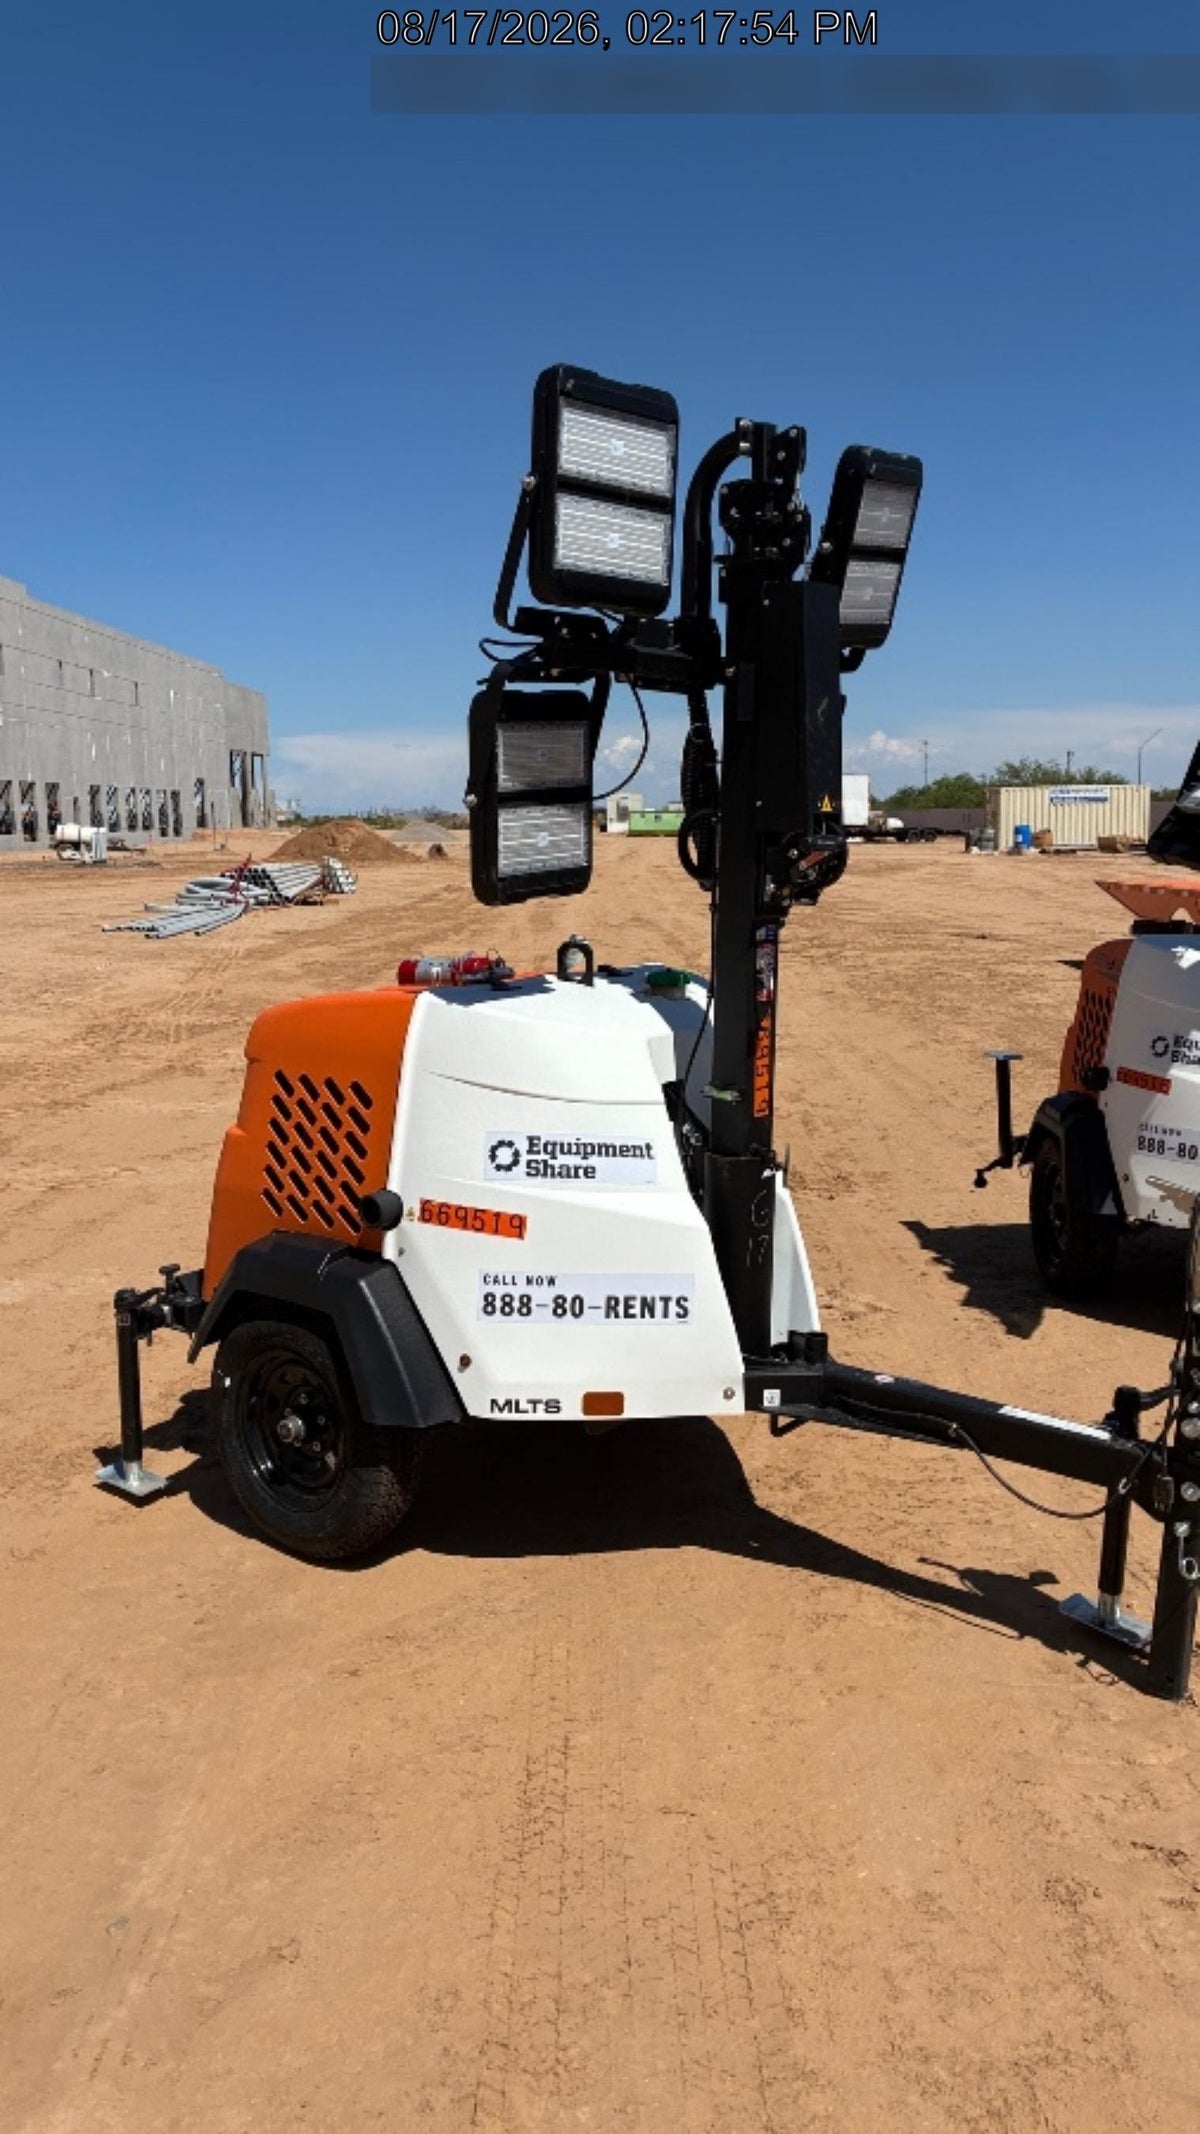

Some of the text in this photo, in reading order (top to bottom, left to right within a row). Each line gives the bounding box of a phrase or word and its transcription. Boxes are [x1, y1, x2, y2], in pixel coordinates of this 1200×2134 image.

[526, 1135, 654, 1161] Equipment
[526, 1160, 596, 1180] Share
[420, 1198, 524, 1239] 669519
[483, 1273, 557, 1287] CALL NOW
[482, 1292, 689, 1320] 888-80-RENTS
[490, 1398, 562, 1414] MLTS
